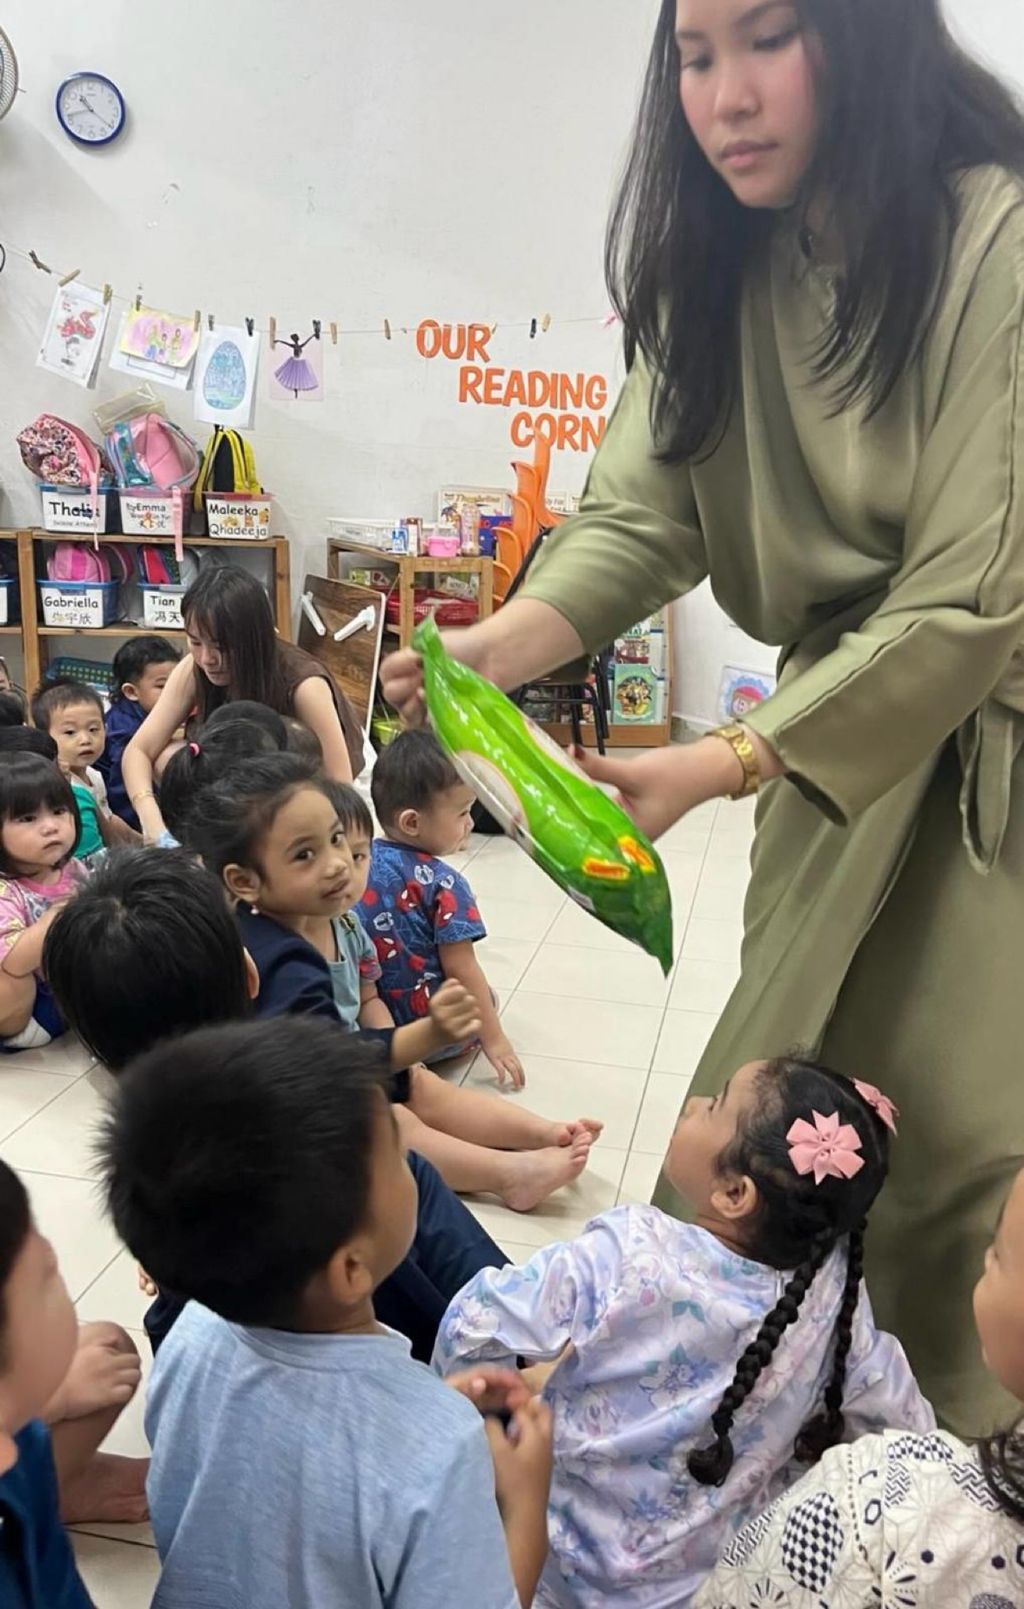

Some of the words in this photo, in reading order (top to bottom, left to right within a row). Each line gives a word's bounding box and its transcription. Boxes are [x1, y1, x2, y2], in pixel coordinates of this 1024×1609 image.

[416, 319, 491, 362] OUR
[459, 366, 608, 410] READING
[209, 503, 259, 516] Maleeka
[210, 523, 267, 539] Qhadeeja
[44, 595, 99, 609] Gabriella
[149, 595, 175, 607] Tian
